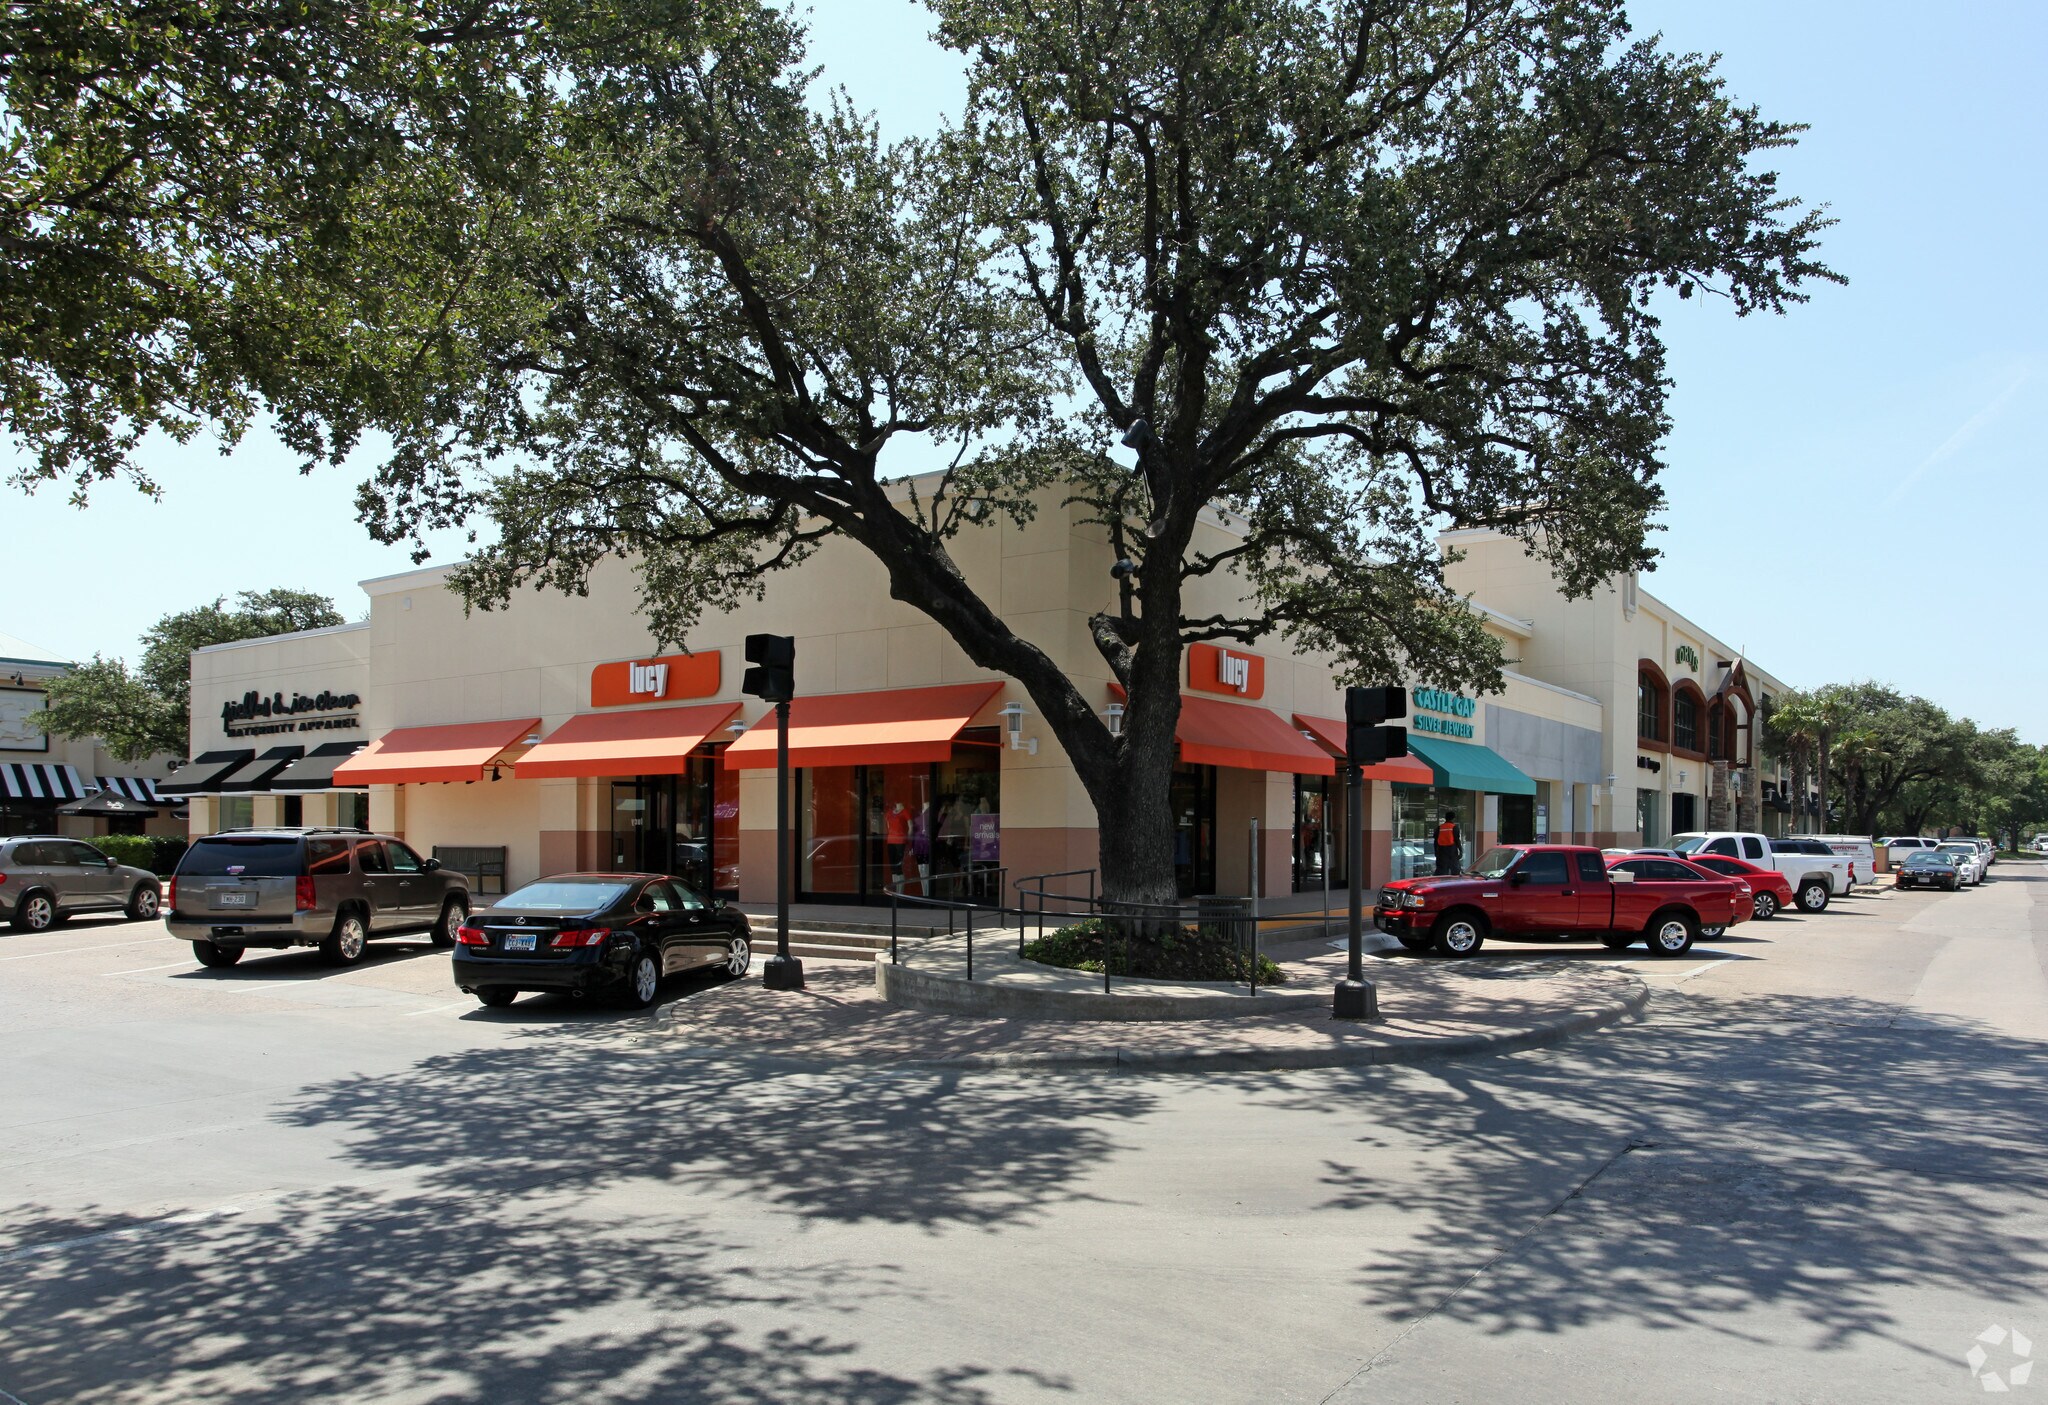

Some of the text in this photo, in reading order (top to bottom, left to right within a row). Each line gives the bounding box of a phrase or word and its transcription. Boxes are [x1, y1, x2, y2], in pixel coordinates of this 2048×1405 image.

[1219, 649, 1249, 693] lucy
[1675, 646, 1698, 672] ORVIS
[629, 661, 669, 697] lucy
[1413, 686, 1476, 718] CASTLE GAP
[226, 718, 360, 737] MATERNITY APPAREL
[1413, 714, 1475, 738] SILVER JEWELRY
[974, 831, 1000, 839] arrivals
